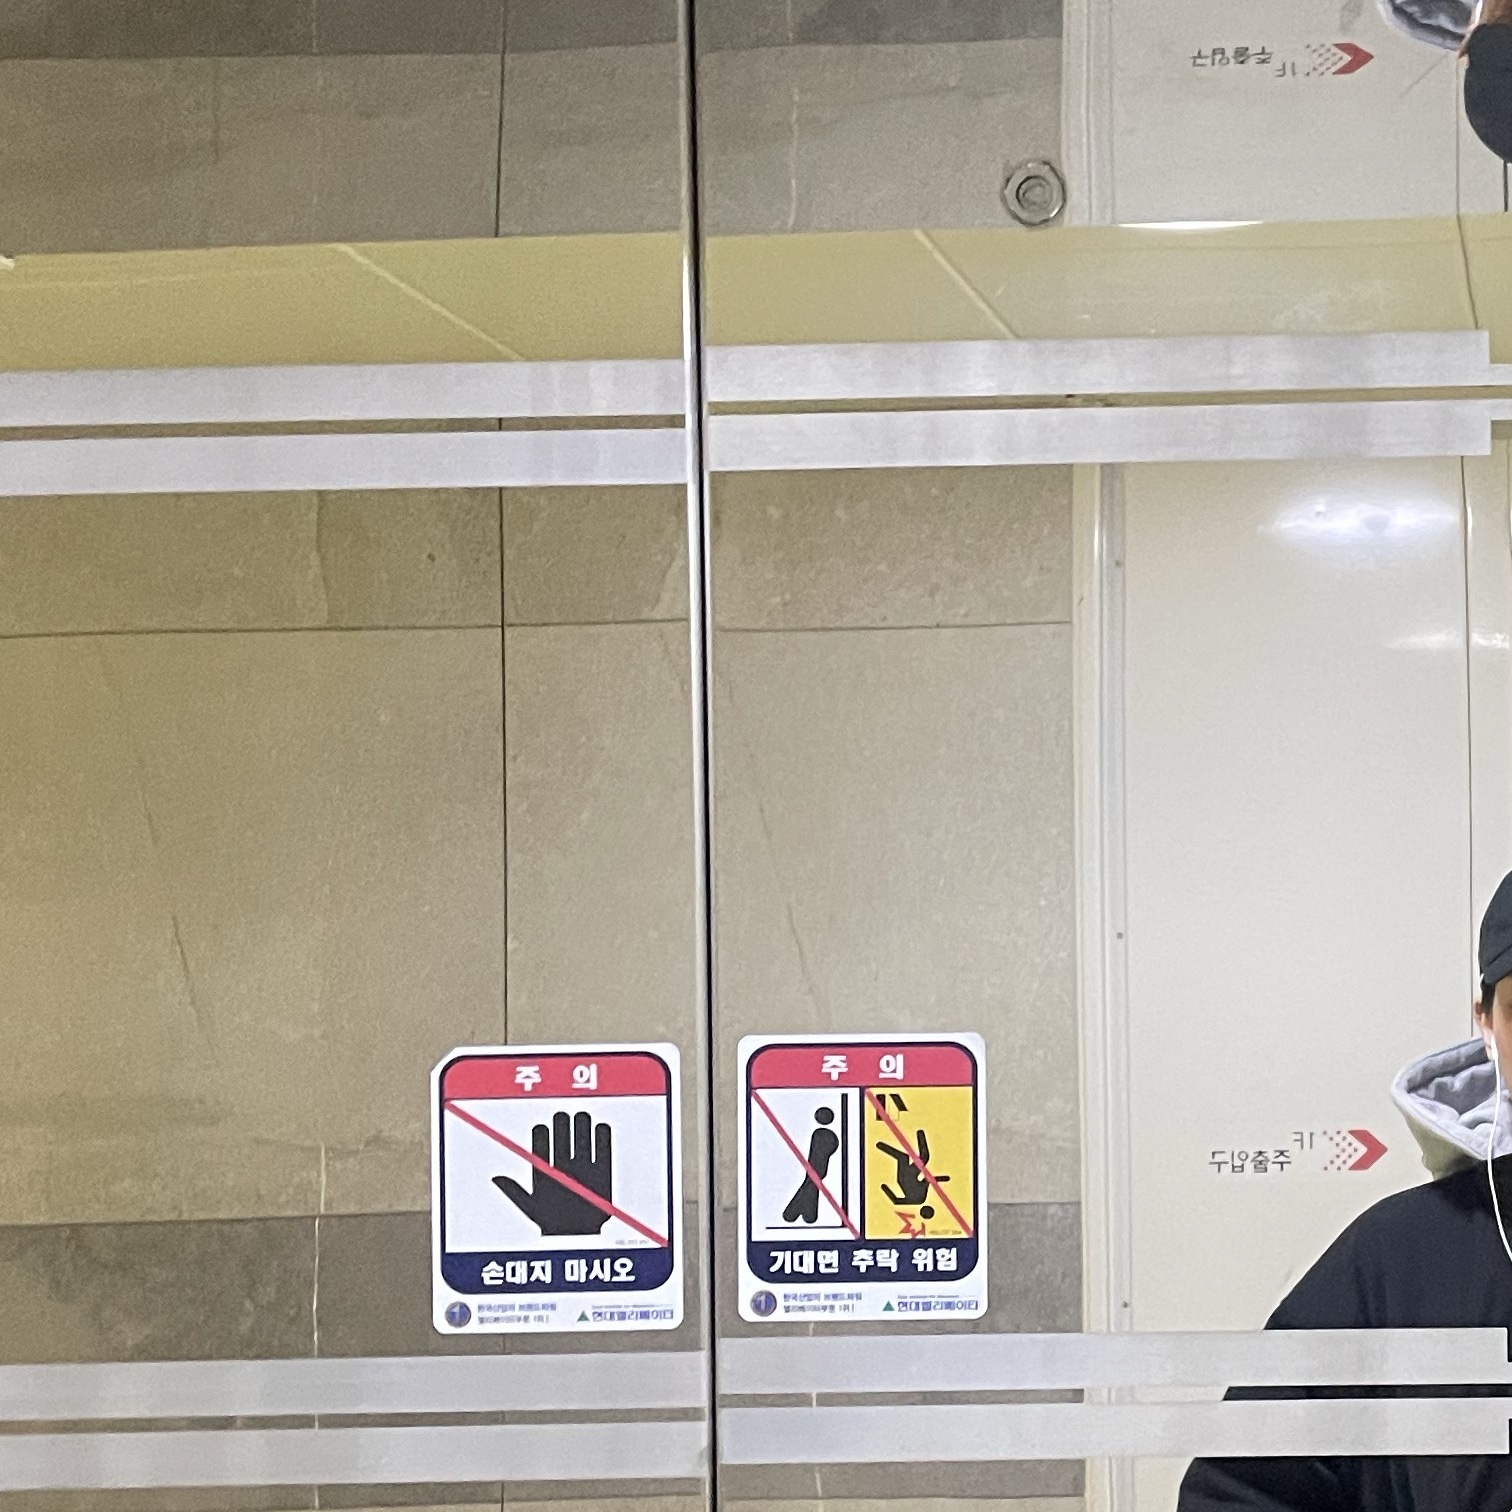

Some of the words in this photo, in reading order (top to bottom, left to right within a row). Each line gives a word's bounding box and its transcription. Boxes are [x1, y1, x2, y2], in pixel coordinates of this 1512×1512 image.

[481, 1259, 552, 1286] 손대지
[564, 1257, 636, 1283] 마시오
[769, 1249, 840, 1275] 기대면
[851, 1248, 900, 1273] 추락
[911, 1247, 958, 1272] 위험
